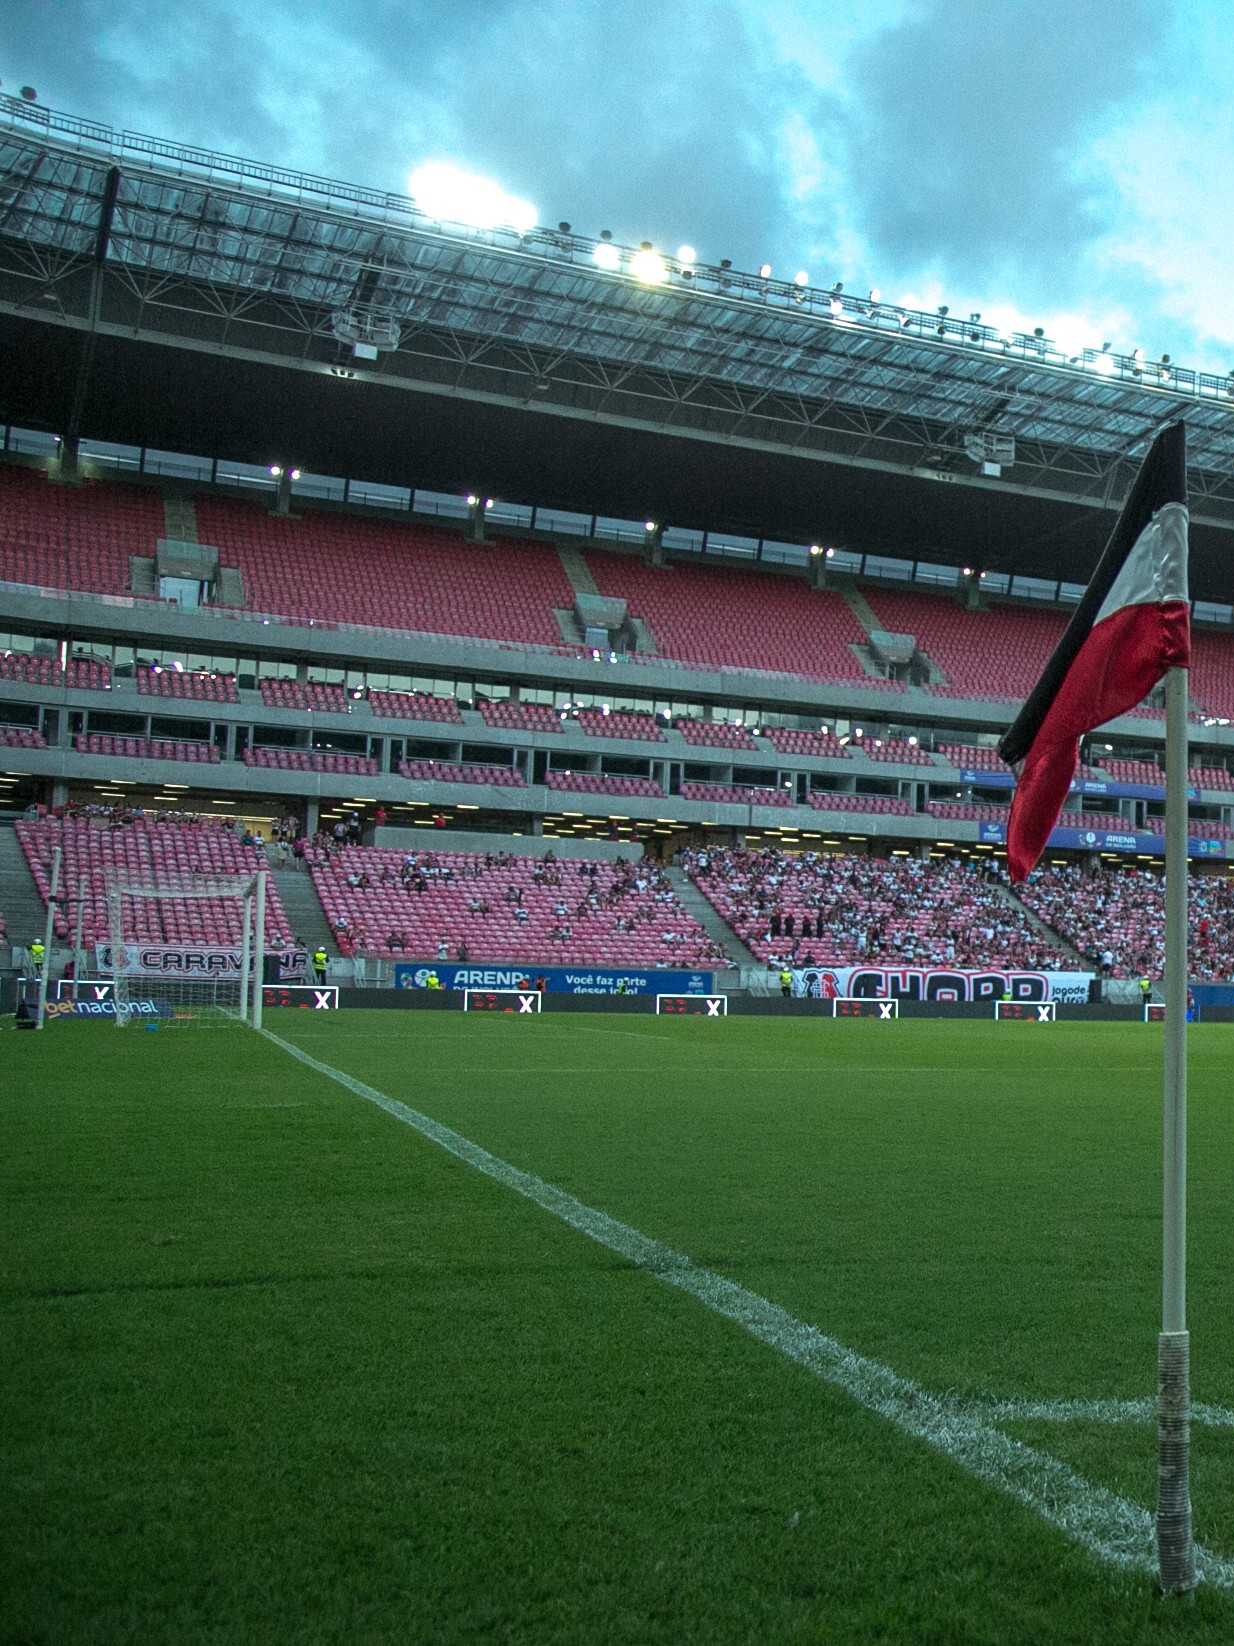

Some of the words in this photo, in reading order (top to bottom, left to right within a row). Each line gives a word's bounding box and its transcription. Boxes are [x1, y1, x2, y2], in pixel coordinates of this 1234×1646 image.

[1106, 835, 1136, 844] ARENA
[565, 974, 594, 985] Você
[596, 975, 614, 985] faz
